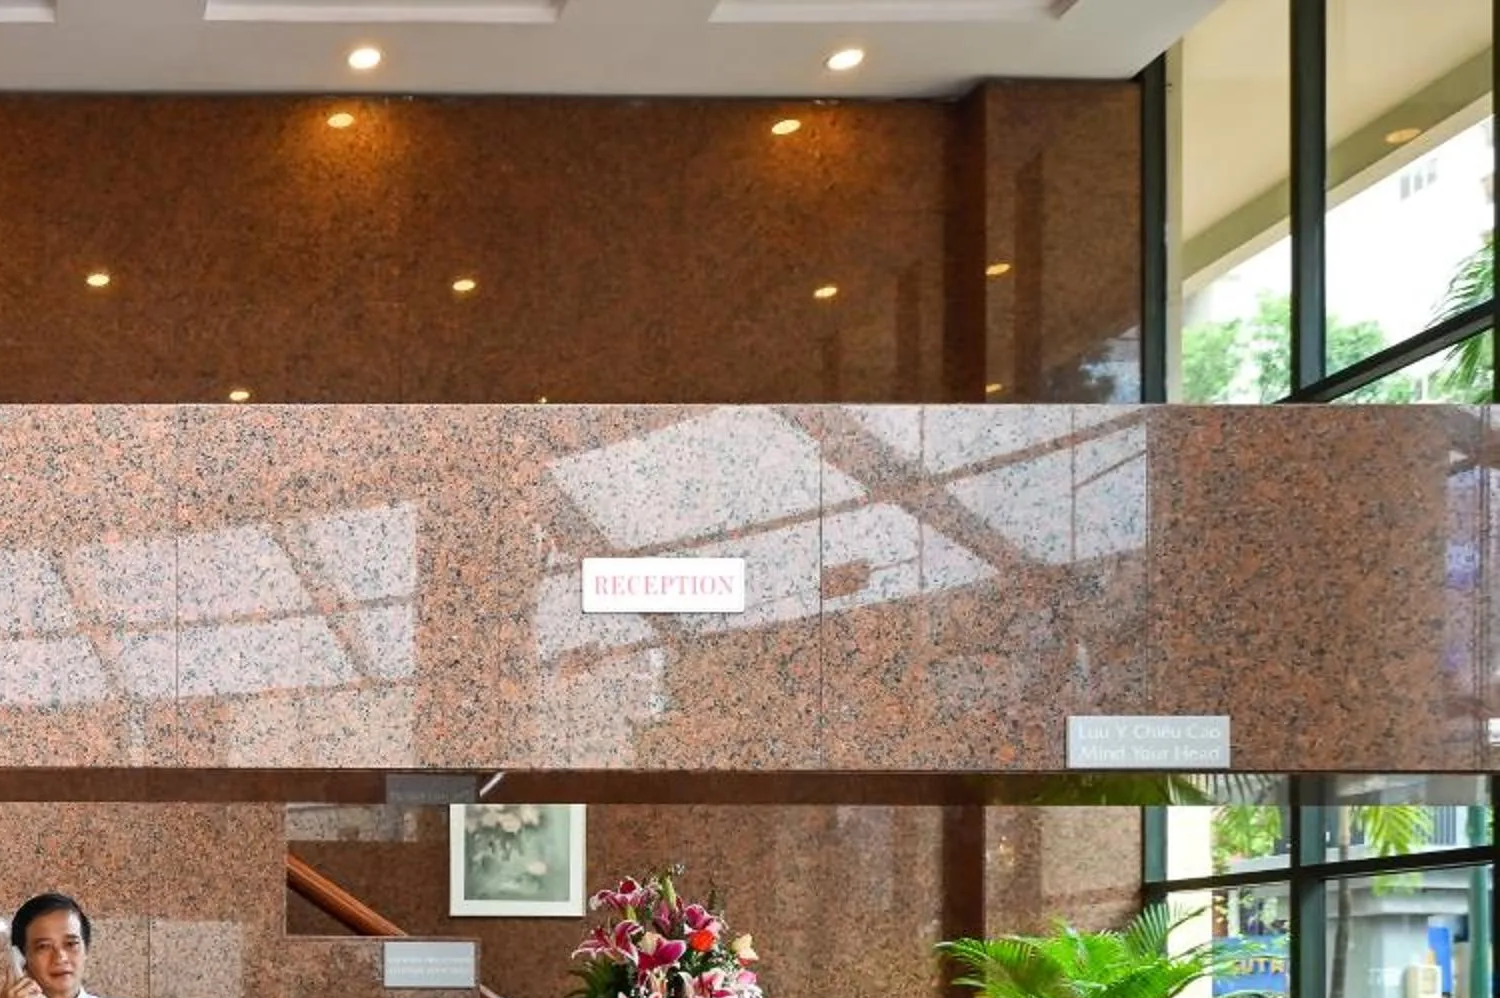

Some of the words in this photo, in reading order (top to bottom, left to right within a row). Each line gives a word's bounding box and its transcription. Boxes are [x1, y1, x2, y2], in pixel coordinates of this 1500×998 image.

[594, 575, 736, 596] RECEPTION
[1079, 745, 1125, 761] Mind
[1131, 746, 1169, 761] Your
[1174, 745, 1221, 761] Head
